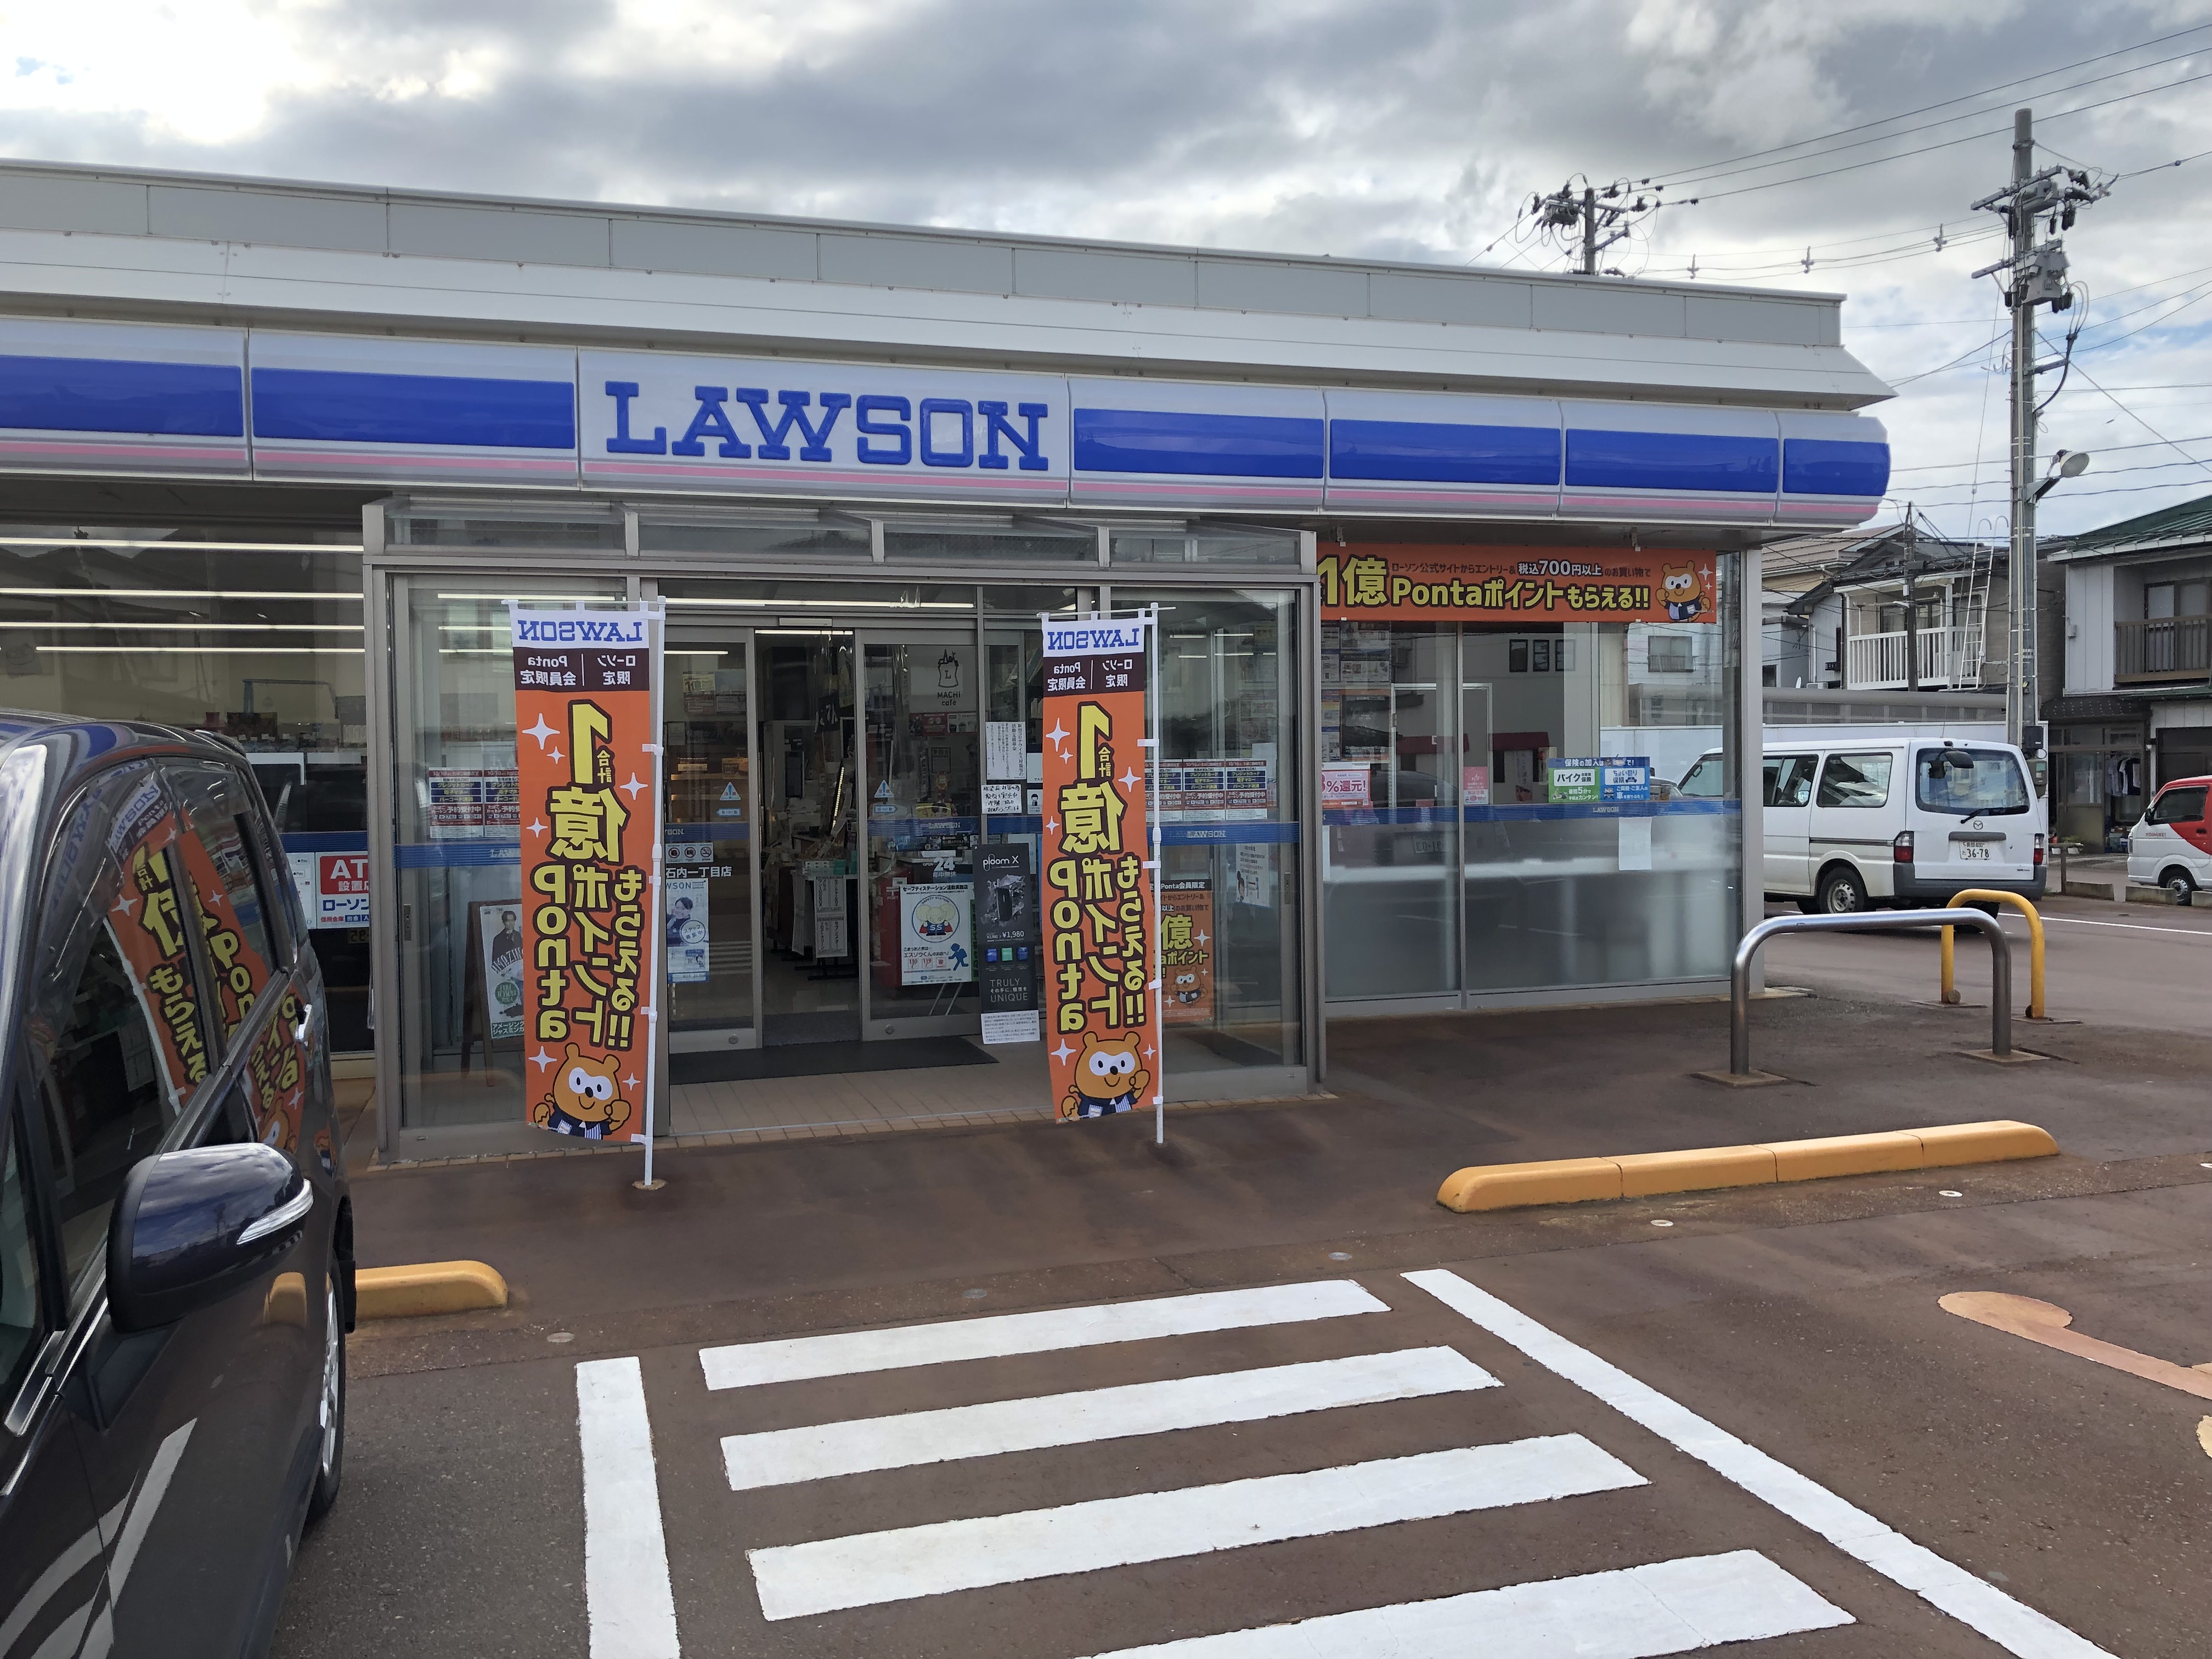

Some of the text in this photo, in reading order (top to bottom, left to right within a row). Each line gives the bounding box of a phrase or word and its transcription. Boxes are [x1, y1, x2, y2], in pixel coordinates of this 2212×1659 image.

[606, 381, 1048, 471] LAWSON
[1565, 758, 1604, 767] 保険の加入は
[1557, 773, 1581, 783] バイク
[1187, 830, 1227, 839] LAWSON
[1967, 848, 1989, 858] 36-78
[933, 856, 955, 871] 24
[1012, 855, 1019, 864] X
[330, 859, 368, 879] AT
[665, 866, 732, 879] 石内一丁目店
[1161, 881, 1205, 889] Ponta会員限定
[1002, 930, 1024, 939] ¥1,980
[1161, 914, 1193, 950] 億
[491, 947, 524, 974] AMAZIN
[1161, 950, 1208, 965] aポイント
[989, 978, 1020, 988] TRULY
[990, 992, 1028, 1003] UNIQUE
